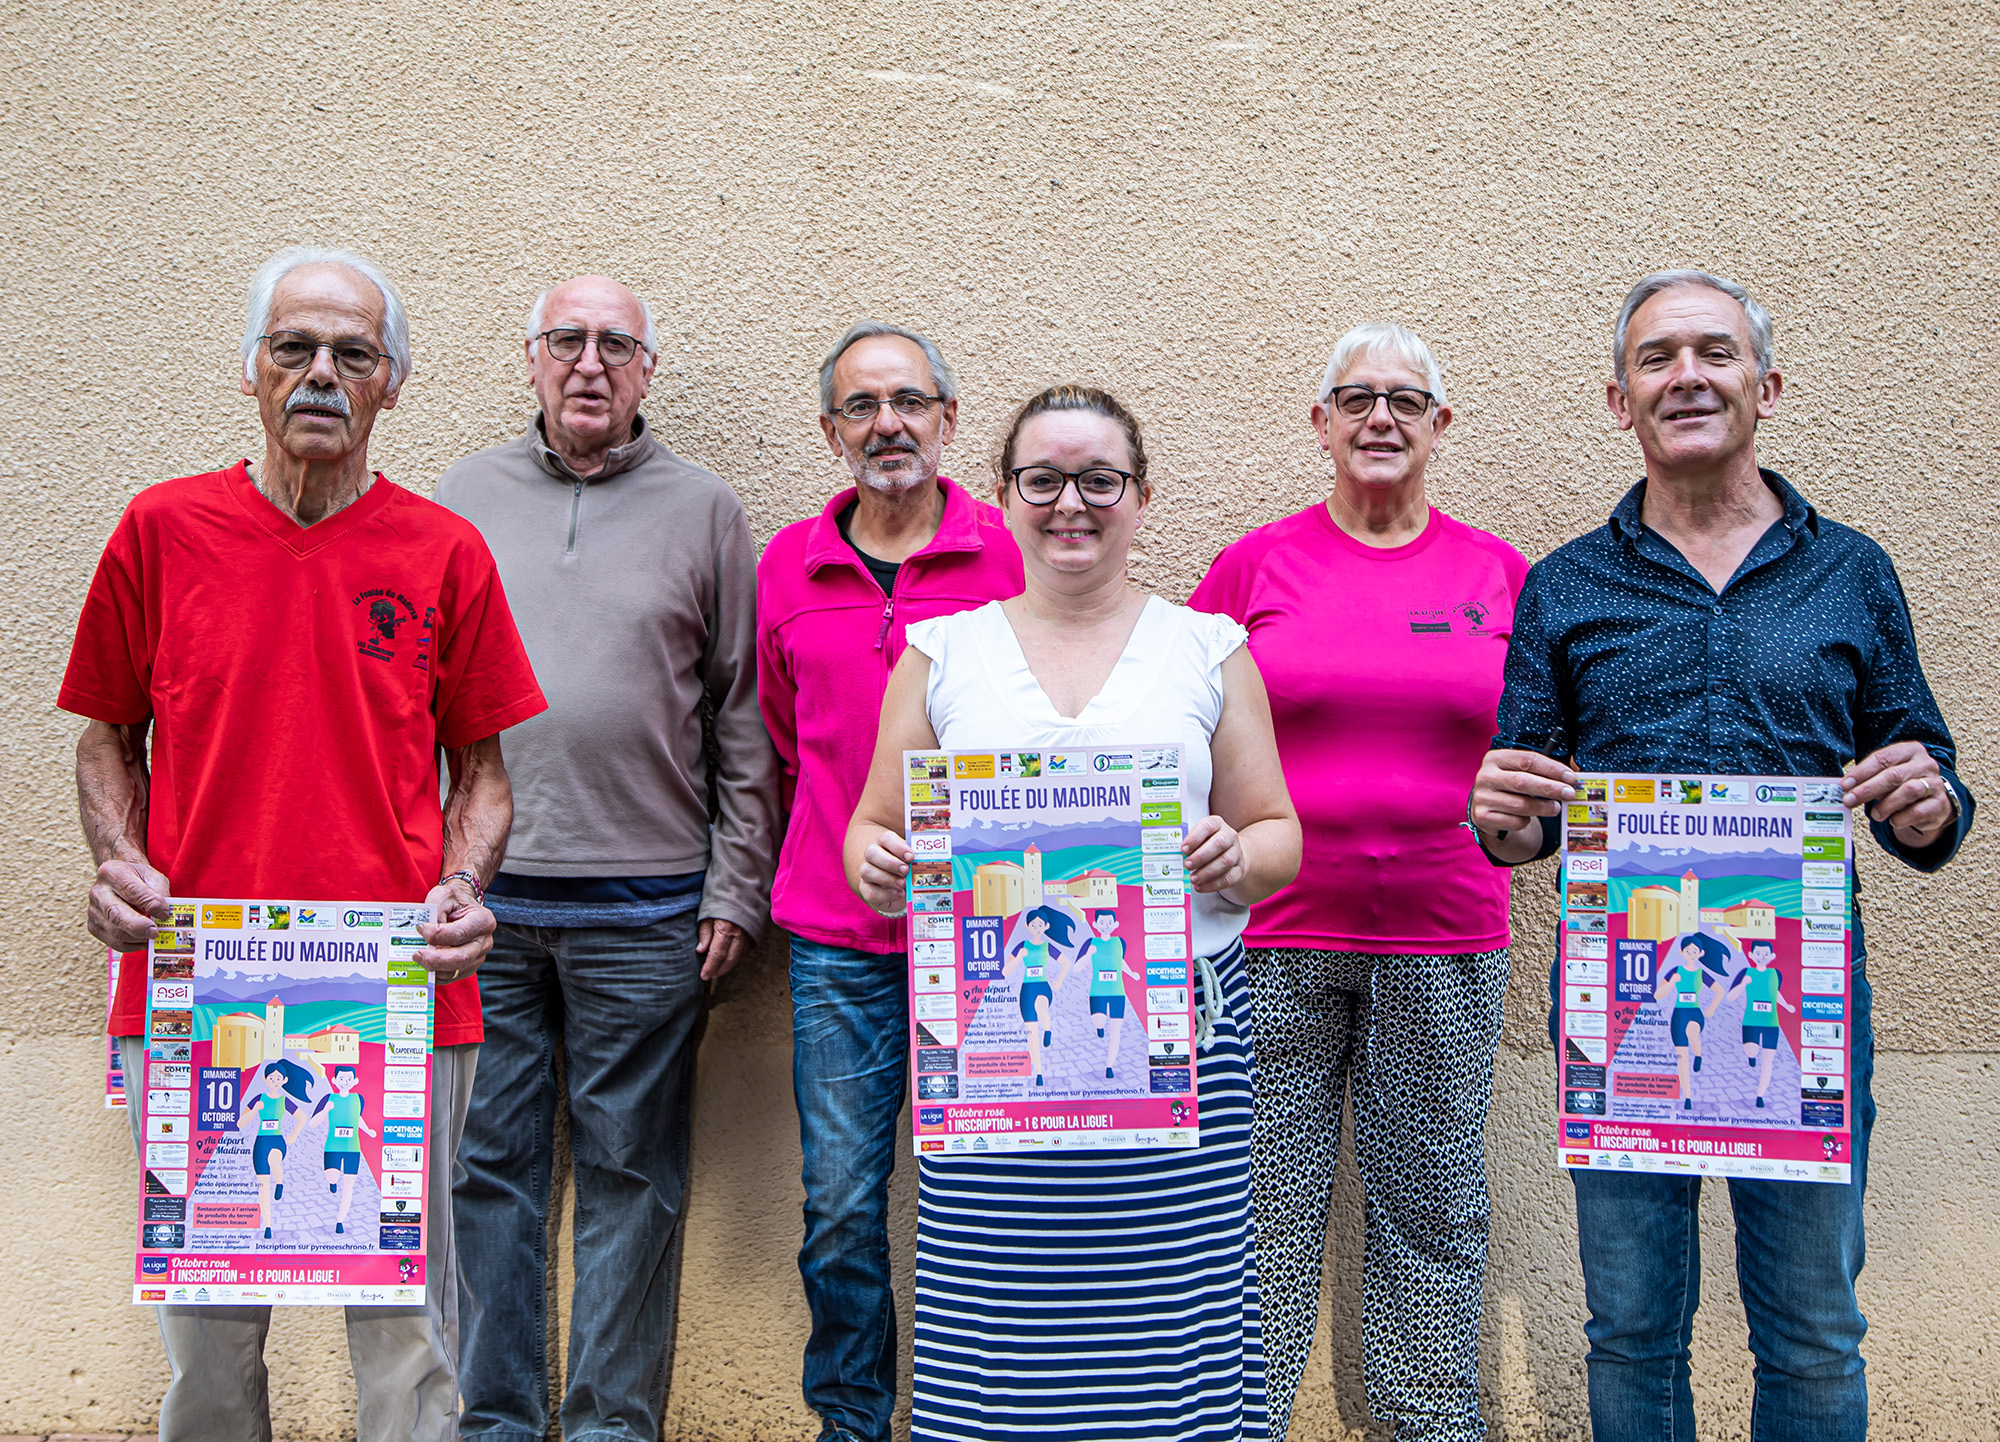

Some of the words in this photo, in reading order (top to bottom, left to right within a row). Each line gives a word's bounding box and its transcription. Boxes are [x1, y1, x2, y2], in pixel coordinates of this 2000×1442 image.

[352, 597, 361, 606] La
[386, 590, 396, 599] du
[960, 785, 1020, 812] FOULÉE
[1026, 788, 1048, 809] DU
[1053, 785, 1130, 809] MADIRAN
[1618, 811, 1680, 835] FOULÉE
[1685, 815, 1707, 836] DU
[1713, 816, 1792, 838] MADIRAN
[966, 919, 999, 929] DIMANCHE
[205, 937, 267, 961] FOULÉE
[272, 941, 294, 962] DU
[300, 942, 378, 962] MADIRAN
[970, 930, 996, 959] 10
[1619, 942, 1652, 951] DIMANCHE
[967, 961, 1000, 972] OCTOBRE
[1623, 953, 1649, 981] 10
[971, 985, 982, 994] Au
[984, 985, 1010, 996] départ
[1619, 984, 1652, 994] OCTOBRE
[983, 994, 1018, 1004] Madiran
[203, 1070, 237, 1079] DIMANCHE
[206, 1081, 233, 1110] 10
[1028, 1090, 1068, 1098] Inscriptions
[1082, 1087, 1145, 1097] pyreneeschrono.fr
[202, 1112, 235, 1122] OCTOBRE
[947, 1107, 984, 1118] Octobre
[947, 1121, 952, 1132] 1
[954, 1118, 1013, 1132] INSCRIPTION
[1025, 1118, 1029, 1129] 1
[1032, 1117, 1038, 1129] €
[1041, 1116, 1065, 1129] POUR
[1067, 1115, 1079, 1128] LA
[1081, 1115, 1108, 1128] LIGUE
[1594, 1124, 1630, 1135] Octobre
[204, 1136, 216, 1144] Au
[218, 1136, 244, 1147] départ
[1593, 1136, 1598, 1148] 1
[1600, 1136, 1659, 1151] INSCRIPTION
[1671, 1140, 1676, 1151] 1
[1678, 1140, 1685, 1152] €
[1688, 1140, 1713, 1153] POUR
[1714, 1141, 1727, 1154] LA
[1729, 1142, 1756, 1156] LIGUE
[1758, 1144, 1762, 1156] !
[203, 1146, 213, 1154] de
[216, 1146, 251, 1155] Madiran
[171, 1257, 208, 1268] Octobre
[170, 1270, 175, 1282] 1
[178, 1270, 237, 1282] INSCRIPTION
[250, 1270, 254, 1282] 1
[257, 1270, 264, 1282] €
[266, 1270, 291, 1282] POUR
[293, 1270, 305, 1282] LA
[307, 1270, 334, 1282] LIGUE
[336, 1270, 340, 1282] !
